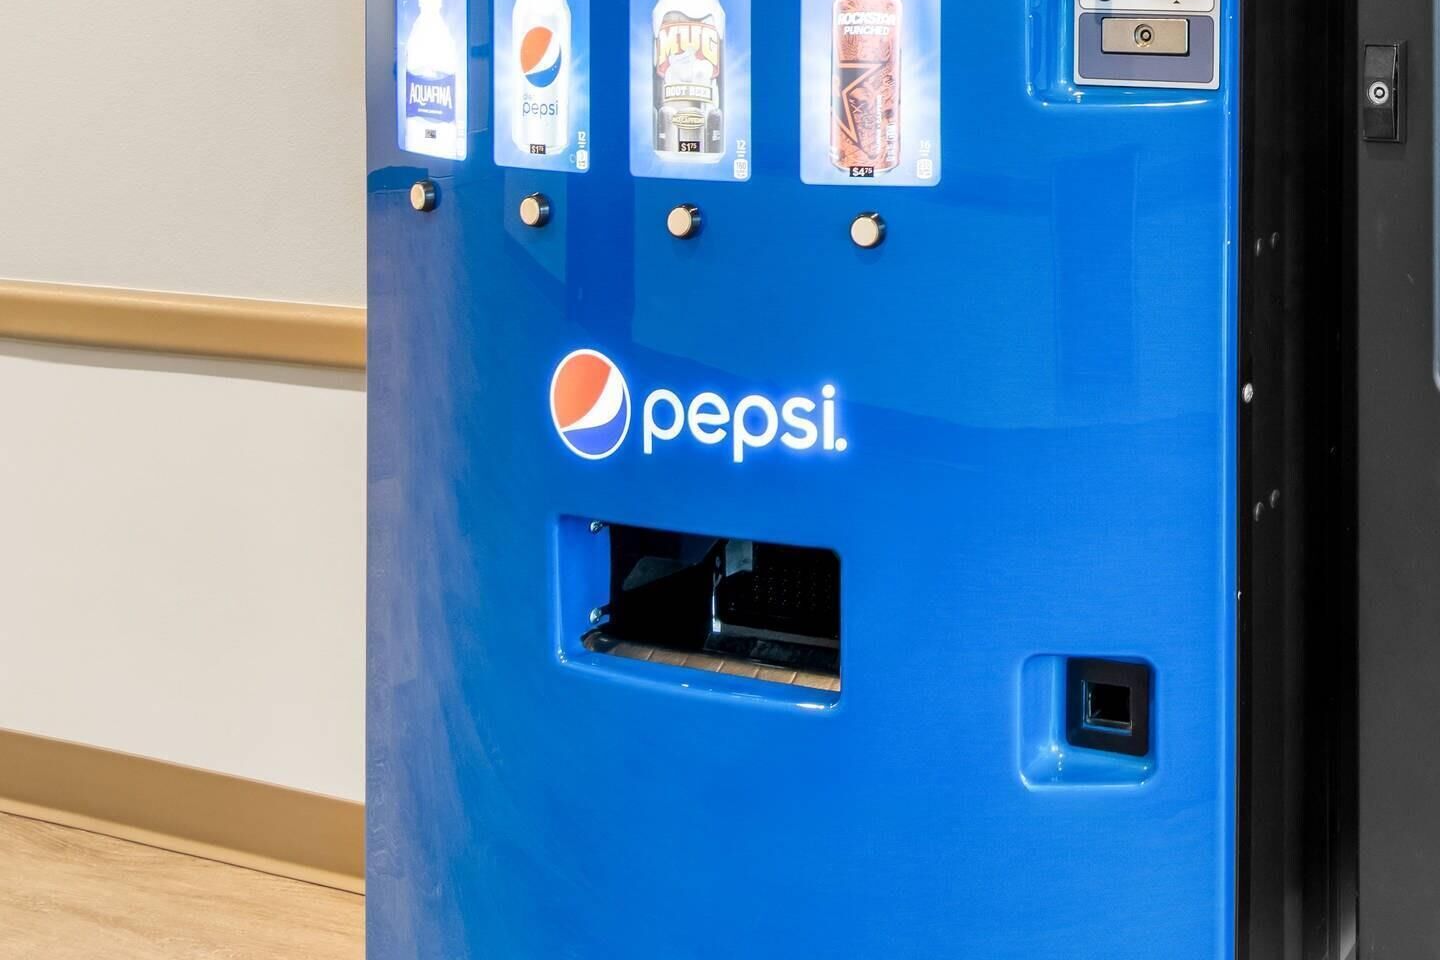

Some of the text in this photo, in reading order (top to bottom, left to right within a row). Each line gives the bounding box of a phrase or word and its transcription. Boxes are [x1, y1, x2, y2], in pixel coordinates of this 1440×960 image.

[659, 26, 719, 66] MUG
[410, 83, 452, 108] AQUAFINA
[522, 101, 558, 119] pepsi
